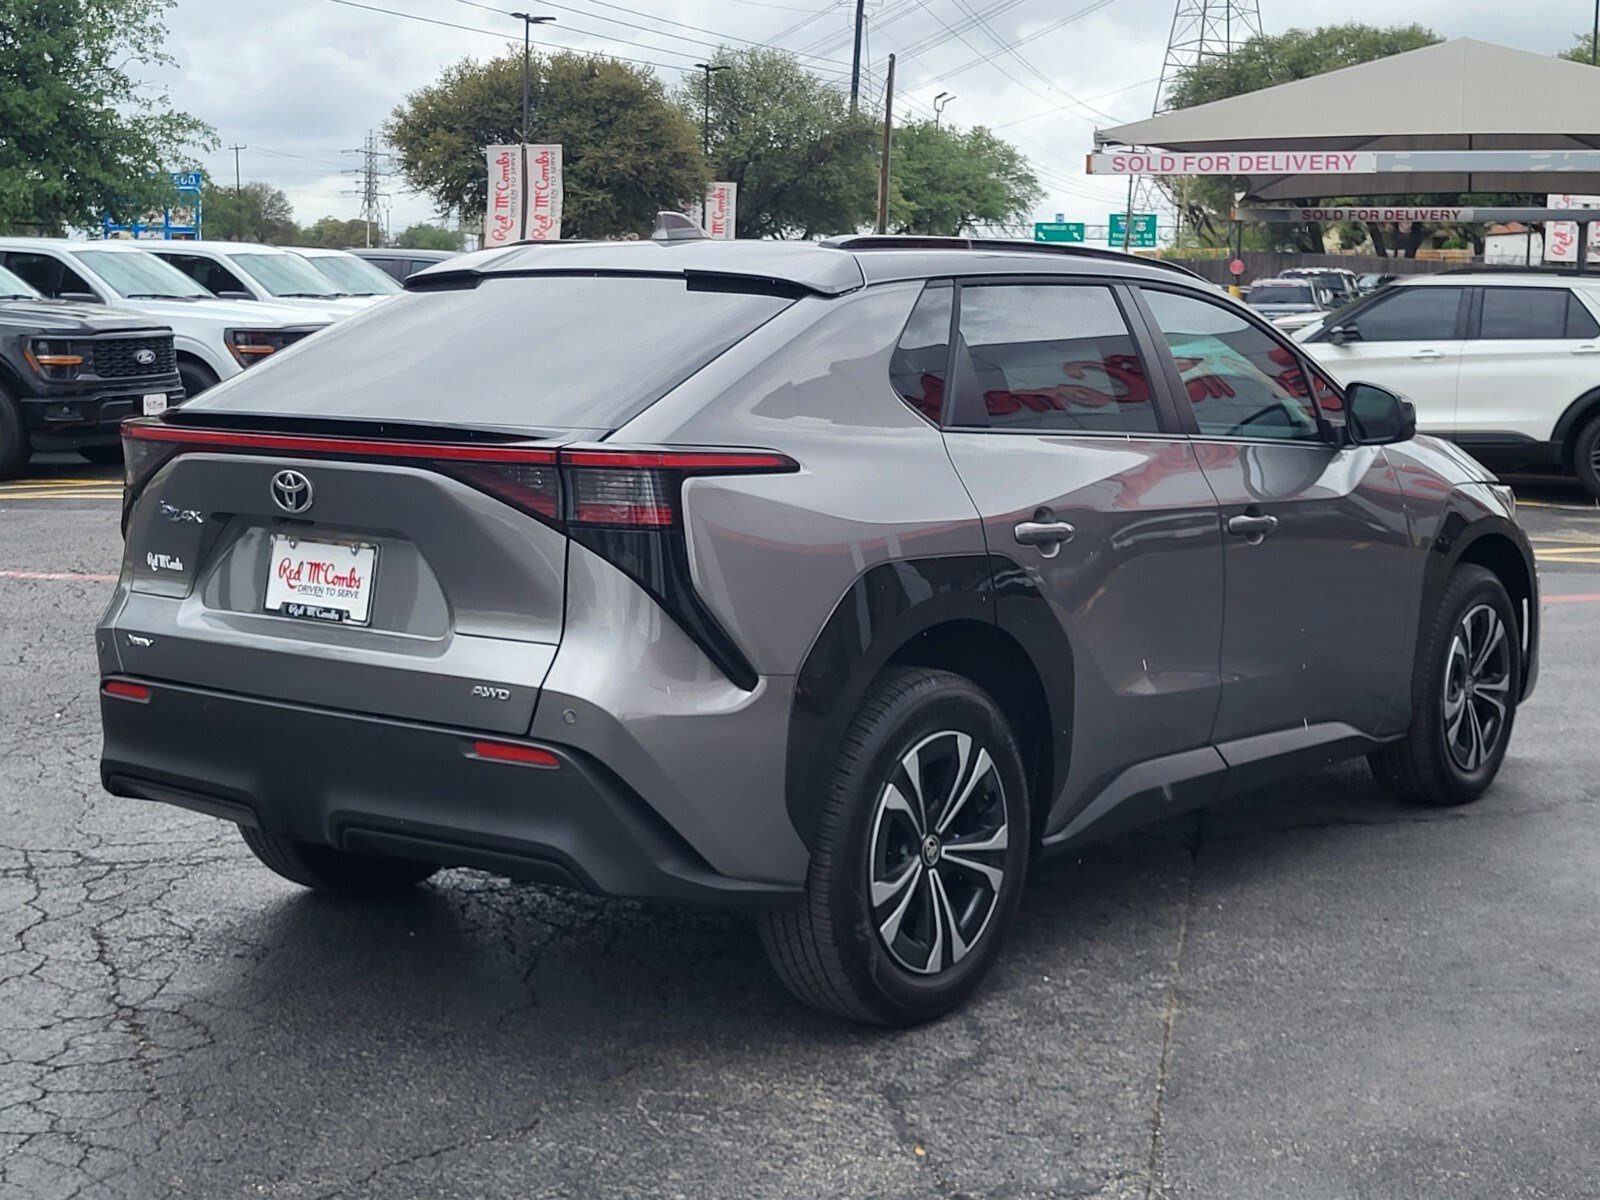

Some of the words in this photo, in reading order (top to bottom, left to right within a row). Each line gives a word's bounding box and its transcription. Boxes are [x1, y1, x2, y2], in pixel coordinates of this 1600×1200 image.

[1112, 156, 1175, 172] SOLD
[1183, 156, 1230, 172] FOR
[1238, 154, 1357, 171] DELIVERY
[495, 152, 510, 211] McCombs
[511, 177, 517, 187] TO
[535, 151, 550, 211] McCombs
[550, 176, 557, 186] TO
[1302, 209, 1344, 221] SOLD
[1350, 209, 1380, 221] FOR
[1384, 209, 1461, 221] DELIVERY
[492, 215, 514, 241] Red
[532, 214, 553, 240] Red
[278, 557, 304, 589] Red
[306, 561, 362, 590] McCombs
[297, 584, 324, 596] DRIVEN
[325, 588, 336, 596] TO
[337, 589, 360, 600] SERVE
[471, 685, 510, 700] AWD
